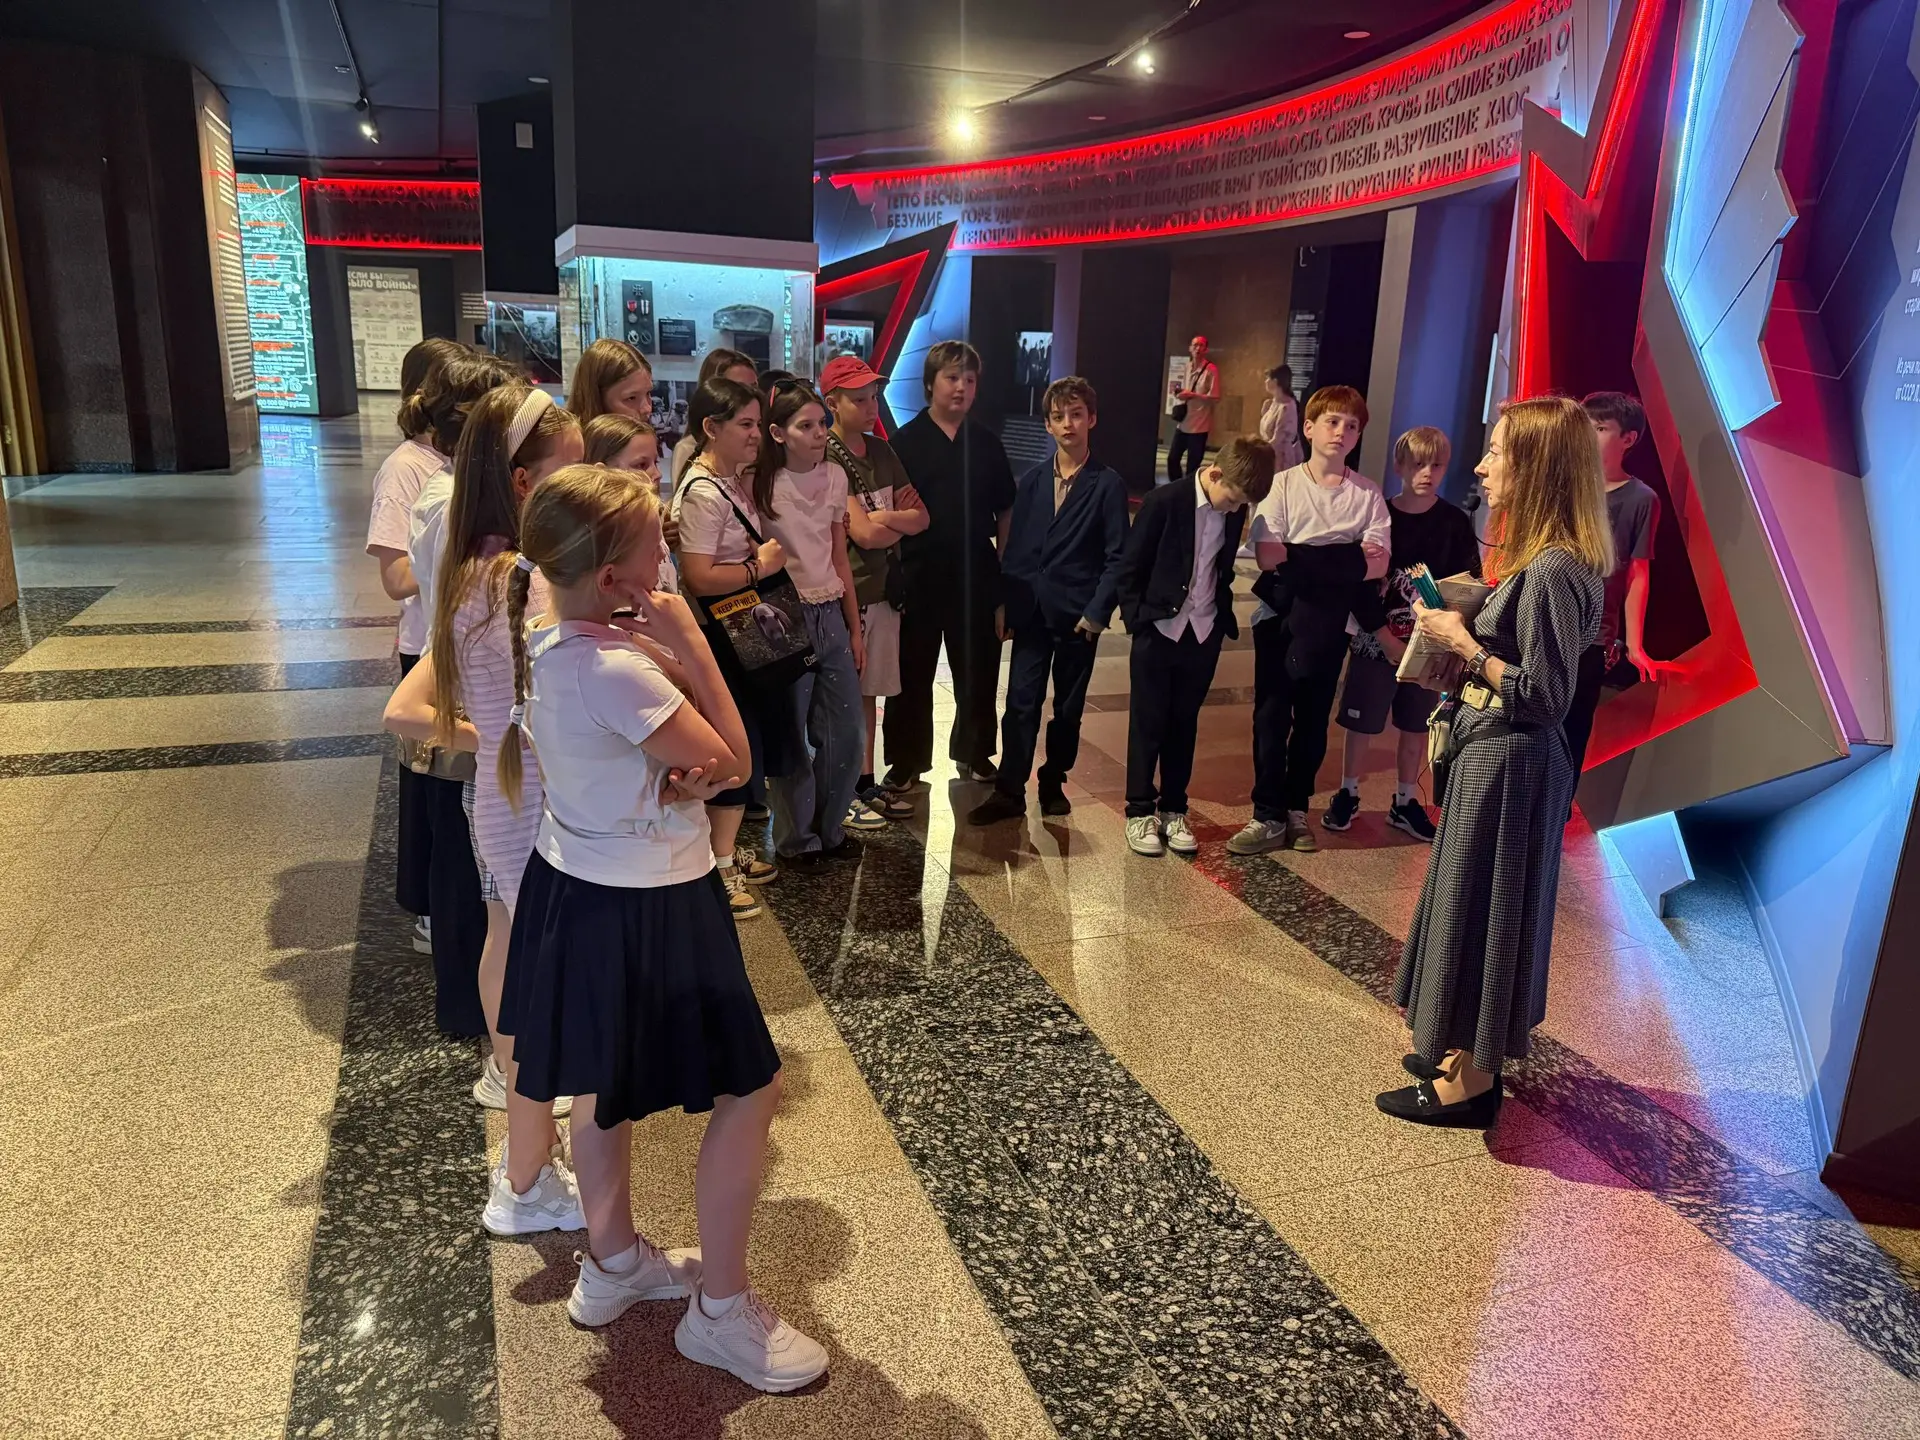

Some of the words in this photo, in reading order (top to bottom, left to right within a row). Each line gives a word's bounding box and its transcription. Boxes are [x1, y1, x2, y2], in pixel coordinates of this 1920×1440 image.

[887, 191, 921, 210] ГЕТТО
[1176, 153, 1218, 178] ПЫТКИ
[1221, 128, 1322, 171] НЕТЕРПИМОСТЬ
[1326, 112, 1375, 146] СМЕРТЬ
[1377, 94, 1421, 131] КРОВЬ
[1424, 62, 1495, 116] НАСИЛИЕ
[1495, 33, 1551, 87] ВОЙНА
[1207, 107, 1307, 148] ПРЕДАТЕЛЬСТВО
[1310, 84, 1370, 121] БЕДСТВИЕ
[1371, 54, 1446, 100] ЭПИДЕМИЯ
[1447, 8, 1536, 72] ПОРАЖЕНИЕ
[887, 211, 943, 228] БЕЗУМИЕ
[961, 207, 991, 224] ГОРЕ
[1224, 171, 1255, 196] ВРАГ
[1258, 155, 1327, 190] УБИЙСТВО
[1331, 141, 1380, 175] ГИБЕЛЬ
[1384, 105, 1480, 161] РАЗРУШЕНИЕ
[962, 227, 1017, 245] ГЕНОЦИД
[1203, 201, 1252, 225] СКОРБЬ
[1255, 184, 1332, 216] ВТОРЖЕНИЕ
[1335, 163, 1414, 203] ПОРУГАНИЕ
[1418, 147, 1468, 185] РУИНЫ
[717, 602, 732, 615] KEEP
[741, 594, 756, 607] WILD
